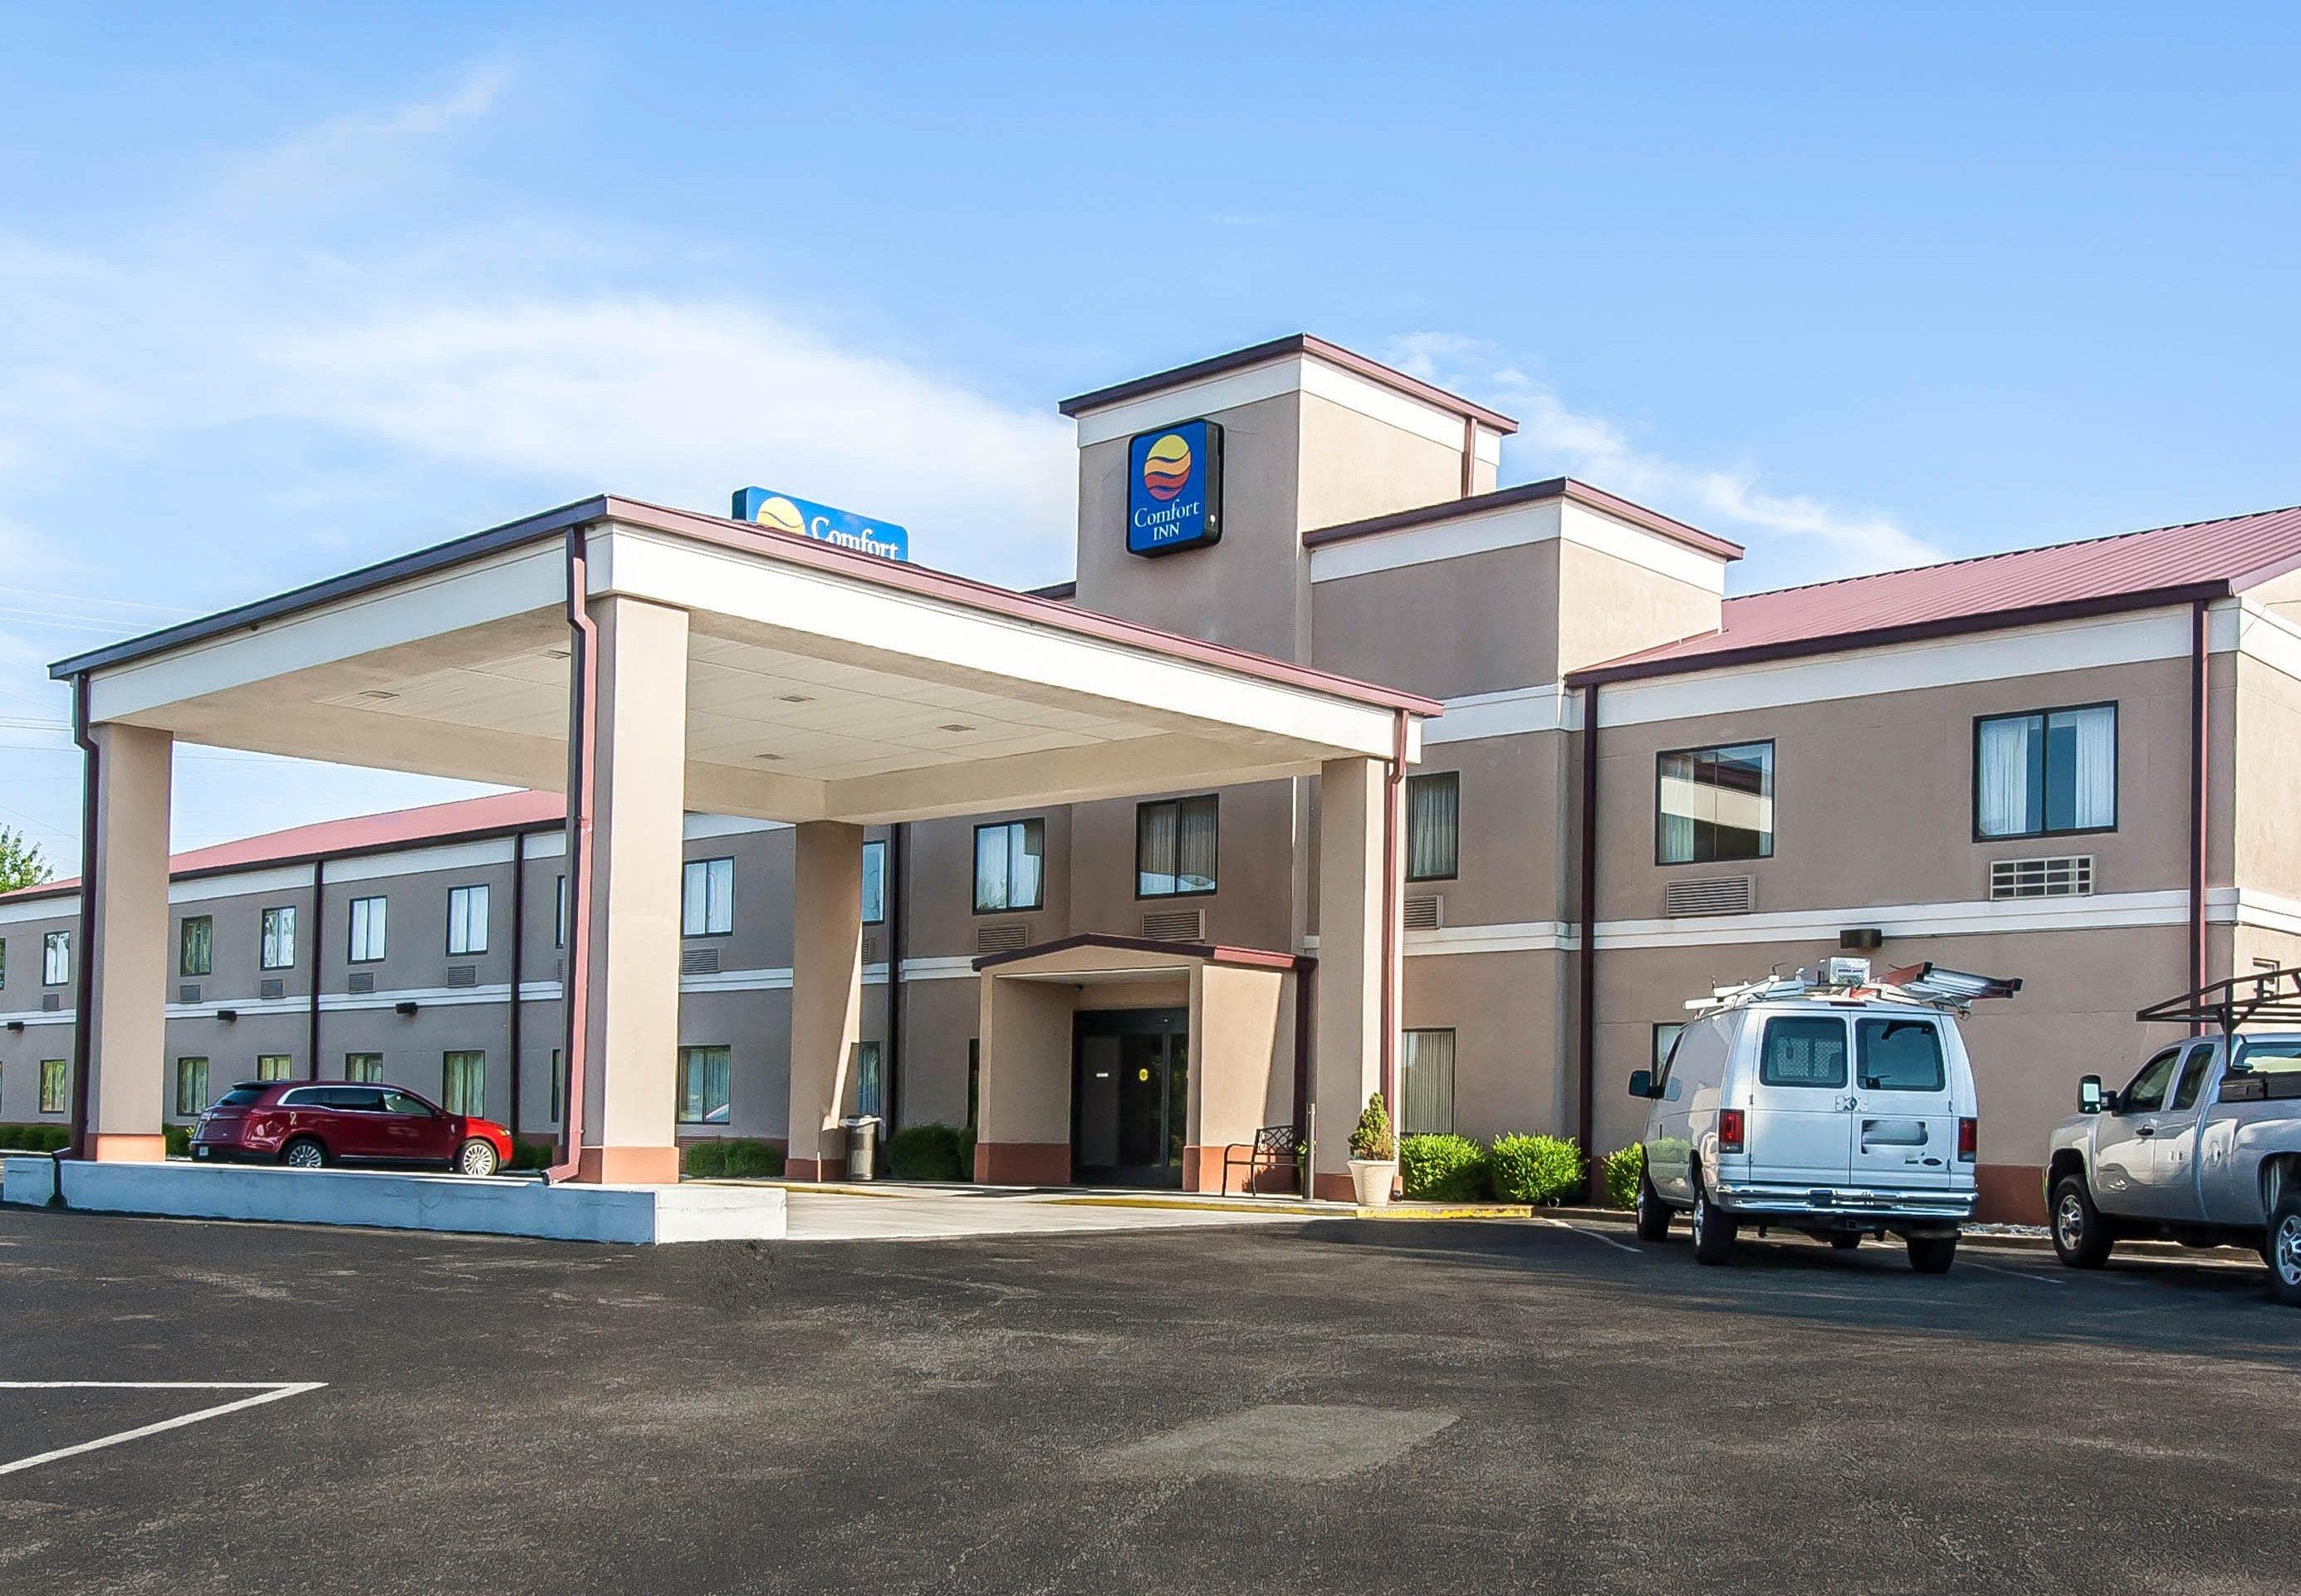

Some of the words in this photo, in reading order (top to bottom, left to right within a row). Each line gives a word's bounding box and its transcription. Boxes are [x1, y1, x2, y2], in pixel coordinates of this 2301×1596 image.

[1134, 498, 1201, 528] Comfort
[810, 516, 898, 561] Comfort
[1153, 522, 1180, 541] INN
